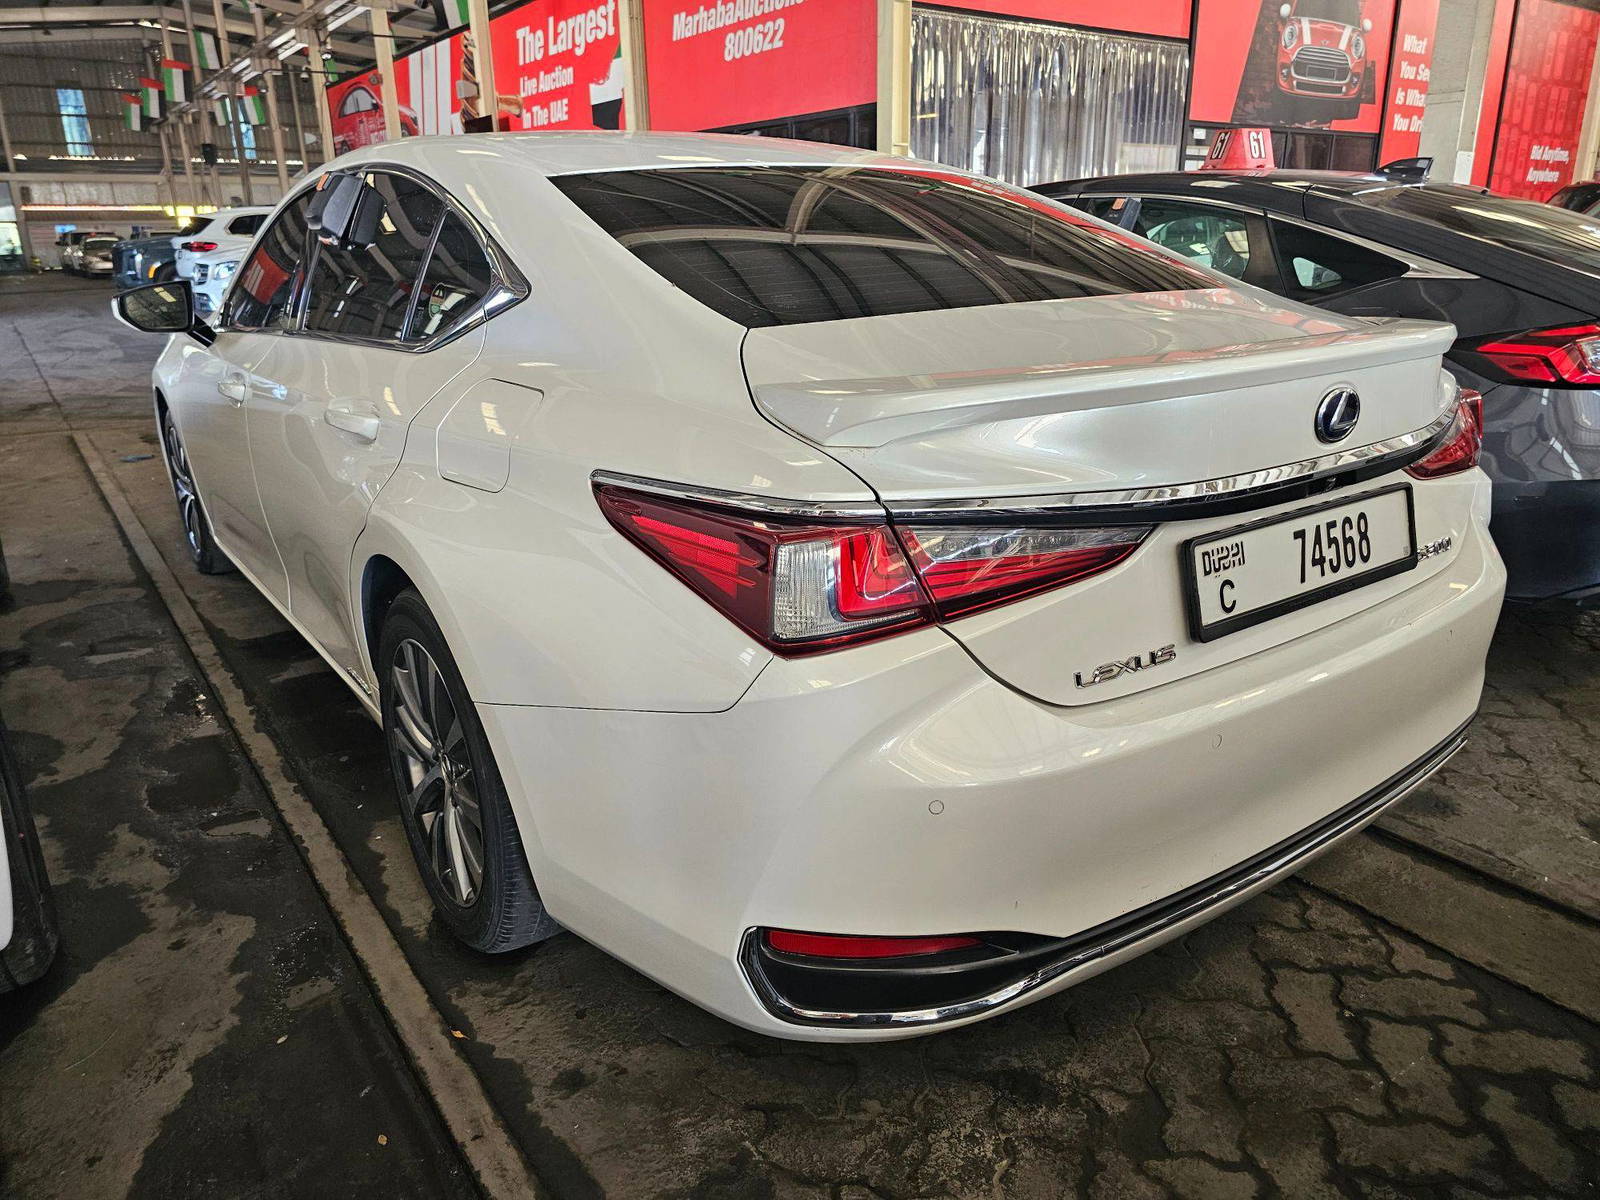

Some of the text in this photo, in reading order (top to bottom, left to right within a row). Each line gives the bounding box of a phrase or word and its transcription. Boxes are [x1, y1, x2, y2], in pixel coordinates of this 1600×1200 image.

[516, 0, 616, 66] The Largest
[672, 0, 805, 41] MarhabaAuc
[724, 17, 785, 62] 800622
[1402, 33, 1428, 54] What
[520, 65, 575, 98] Live Auction
[1400, 61, 1417, 80] You
[531, 105, 549, 127] The
[549, 97, 569, 123] UAE
[1395, 87, 1427, 108] Is Wha
[1393, 113, 1411, 132] You
[1211, 131, 1232, 159] 61
[1249, 131, 1266, 159] 61
[1293, 511, 1371, 584] 74568
[1219, 579, 1237, 613] C
[1073, 643, 1177, 689] LEXUS
